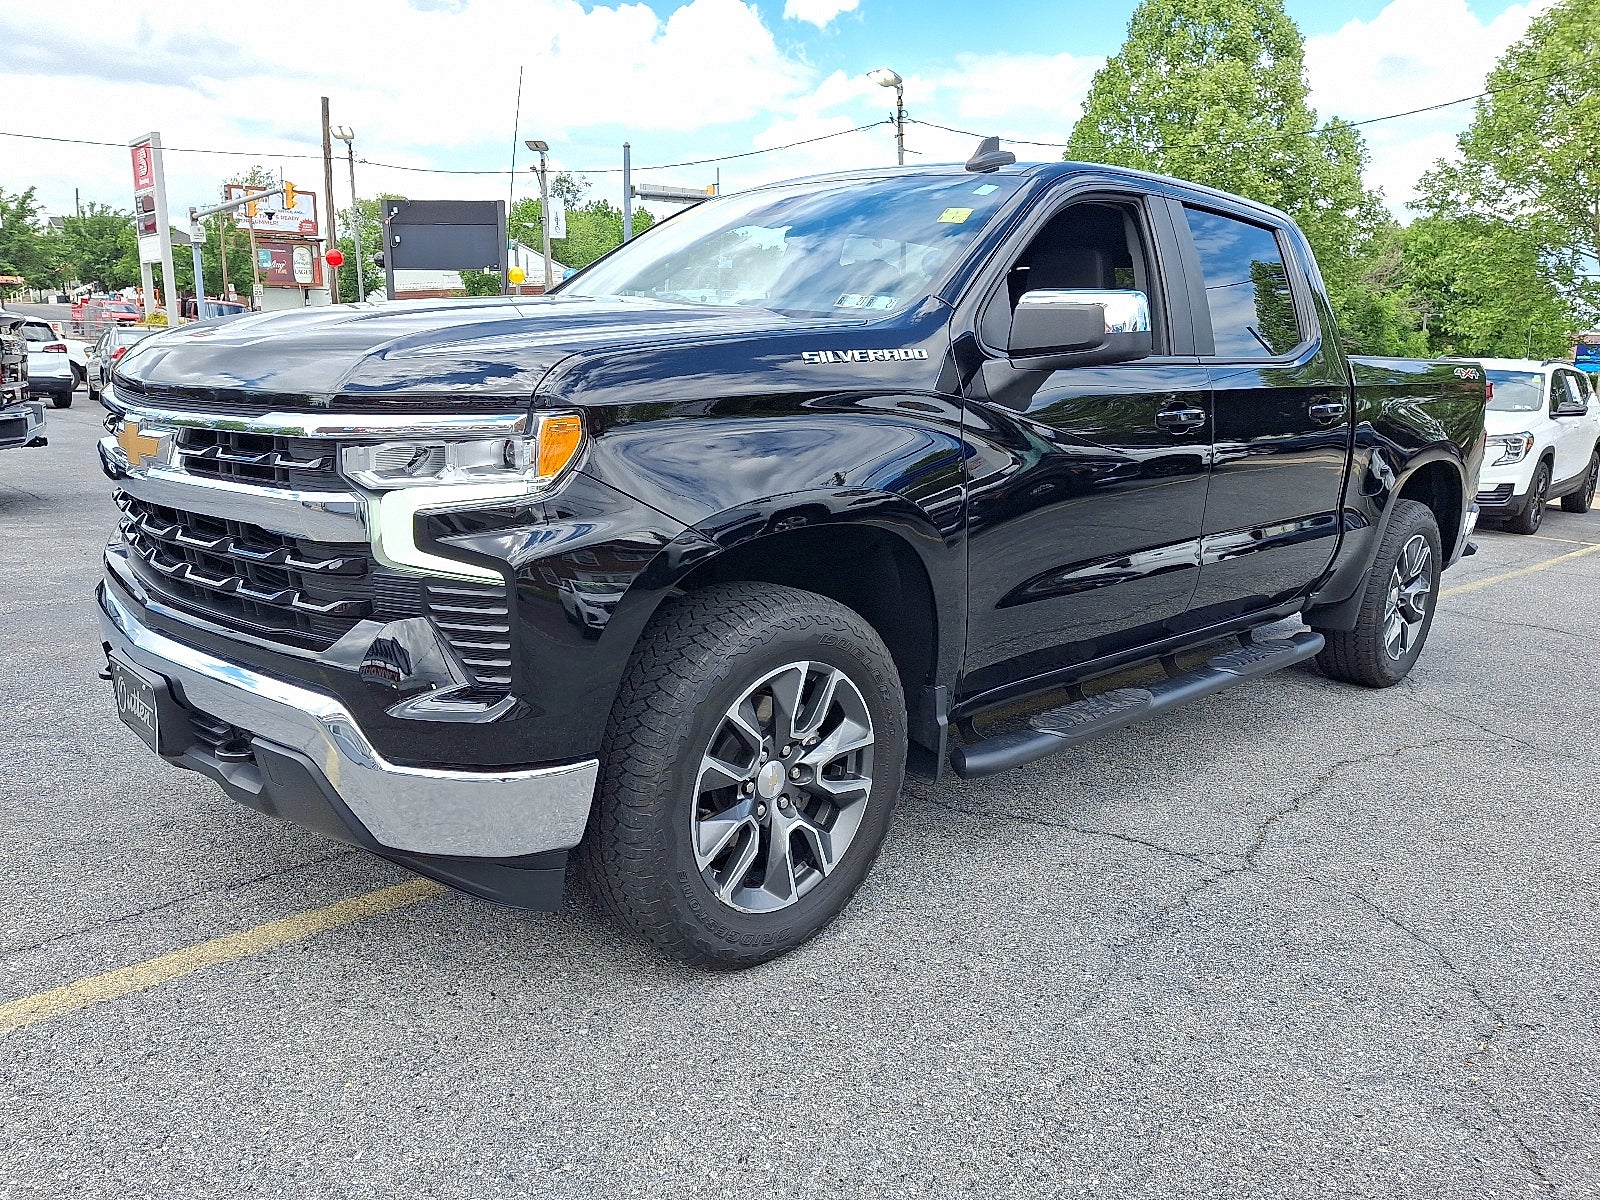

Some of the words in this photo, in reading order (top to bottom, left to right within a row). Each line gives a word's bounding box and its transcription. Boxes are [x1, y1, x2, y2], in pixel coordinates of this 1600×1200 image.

[801, 348, 929, 365] SILVERADO
[818, 632, 891, 700] DUELER
[117, 675, 155, 731] Outten
[677, 869, 793, 948] BRIDGESTONE
